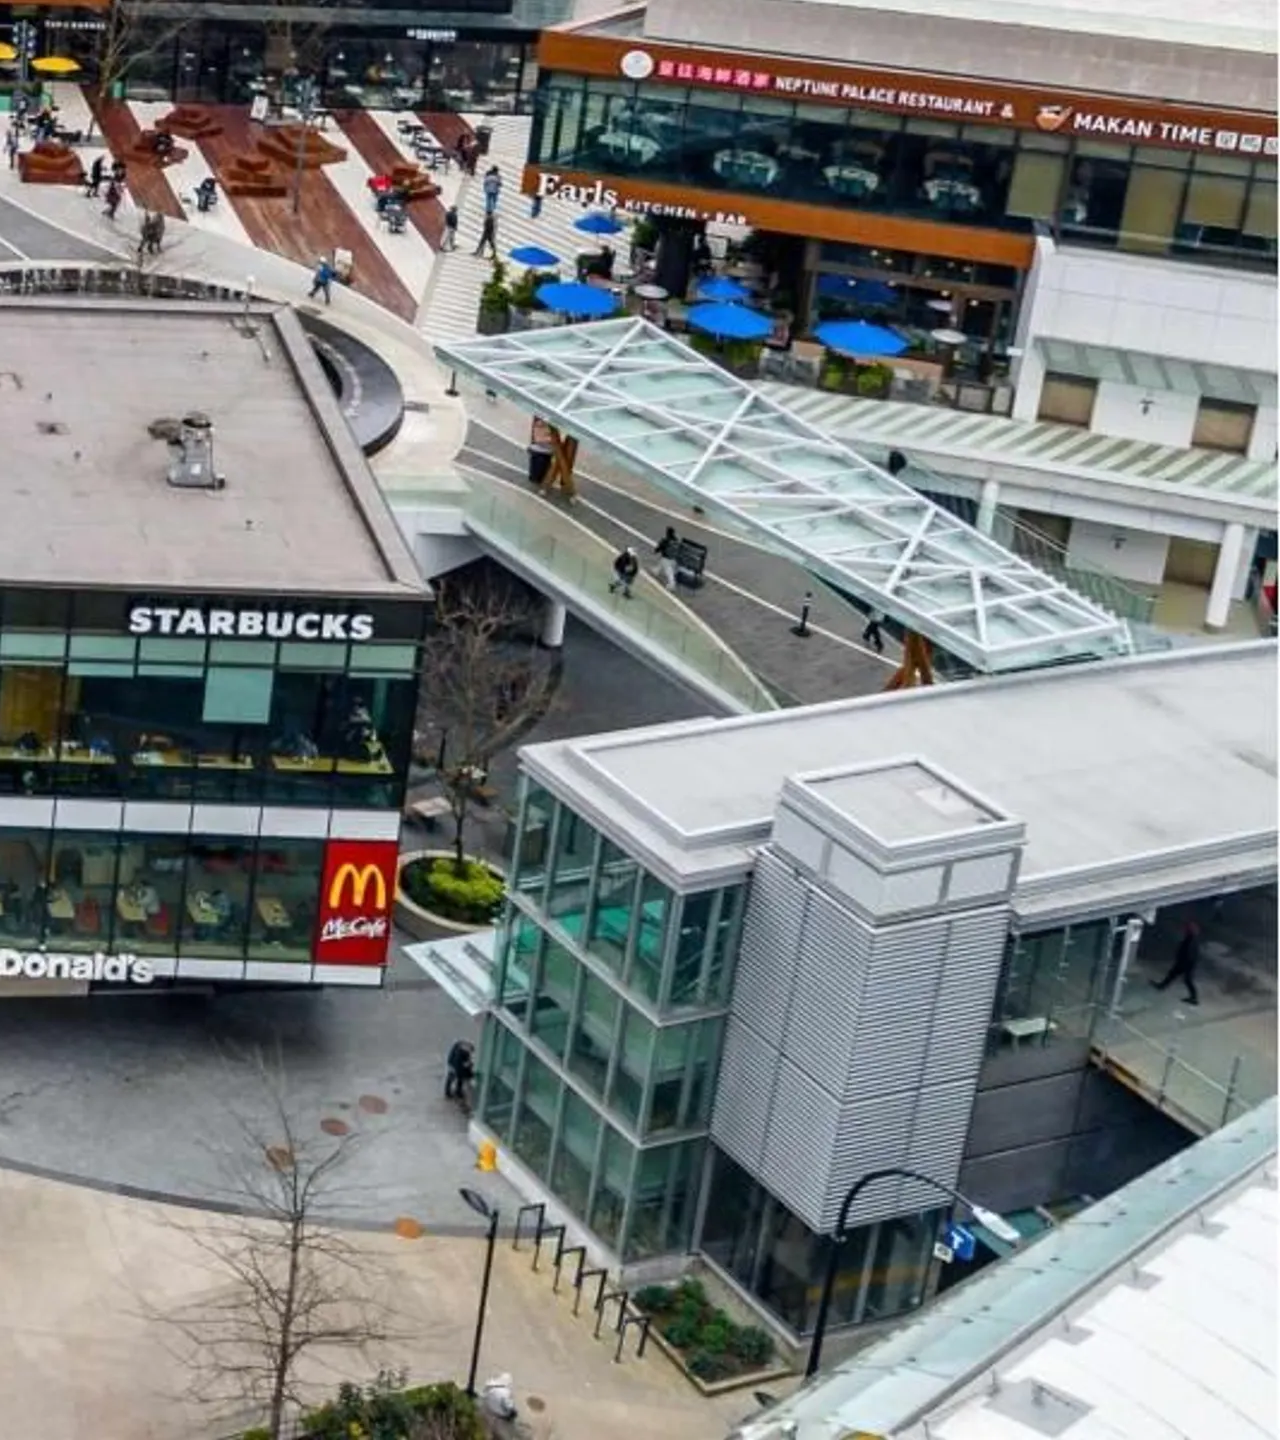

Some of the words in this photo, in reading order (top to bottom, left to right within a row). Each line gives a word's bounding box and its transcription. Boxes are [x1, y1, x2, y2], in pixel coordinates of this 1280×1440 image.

[775, 76, 839, 97] NEPTUNE
[840, 85, 894, 105] PALACE
[897, 91, 996, 116] RESTAURANT
[1000, 103, 1014, 118] &
[1073, 113, 1153, 138] MAKAN
[1160, 124, 1214, 146] TIME
[536, 172, 620, 209] Earls
[624, 199, 697, 219] KITCHEN
[715, 211, 747, 225] BAR
[128, 606, 374, 640] STARBUCKS
